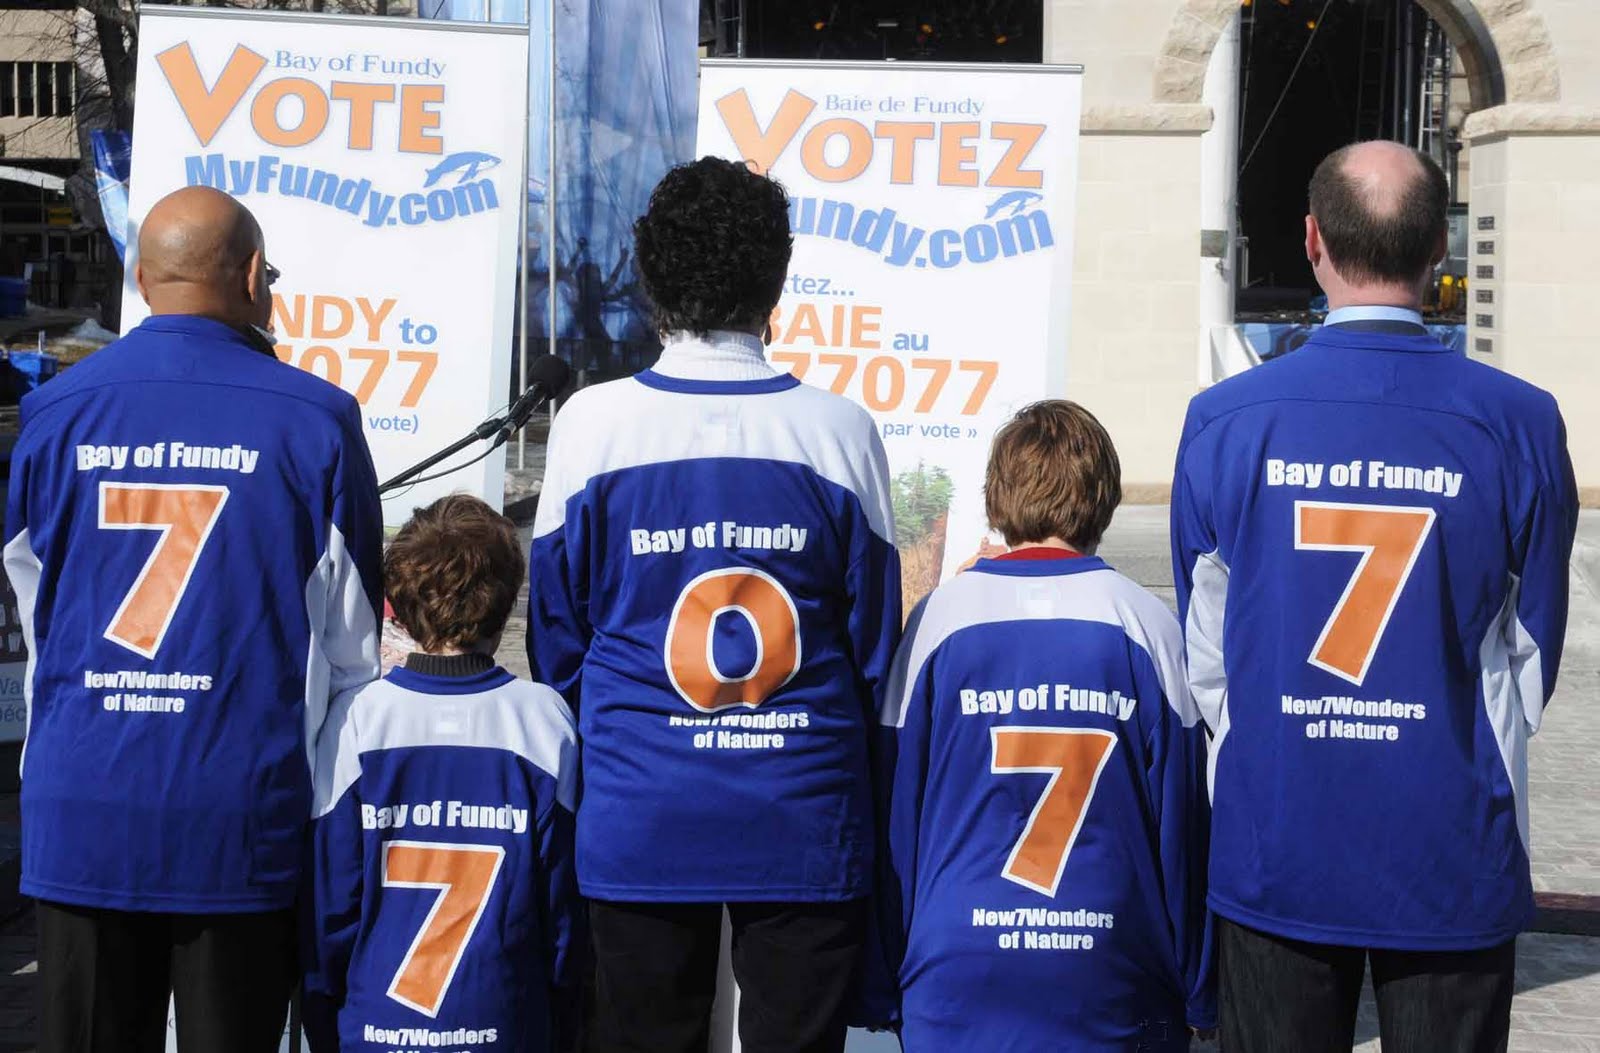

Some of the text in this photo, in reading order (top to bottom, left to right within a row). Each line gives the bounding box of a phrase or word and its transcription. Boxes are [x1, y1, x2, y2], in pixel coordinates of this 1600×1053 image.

[274, 49, 446, 78] Bay of Fundy
[825, 95, 985, 116] Baie de Fundy
[714, 87, 1047, 188] VOTEZ
[184, 153, 501, 228] MyFundy.com
[788, 197, 1055, 268] undy.com
[783, 274, 854, 296] tez...
[272, 293, 438, 345] NDY to
[770, 304, 929, 351] AIE au
[274, 345, 438, 408] 077
[369, 414, 419, 434] vote)
[882, 423, 913, 438] par
[920, 424, 960, 438] vote
[76, 442, 259, 473] Bay of Fundy
[1267, 459, 1463, 497] Bay of Fundy
[630, 522, 807, 555] Bay of Fundy
[98, 481, 230, 660] 7
[1294, 500, 1436, 686] 7
[104, 694, 185, 713] of Nature
[960, 689, 1014, 715] Bay
[1018, 684, 1049, 710] of
[1281, 695, 1425, 719] New7Wonders
[694, 731, 784, 749] of Nature
[1306, 720, 1398, 741] of Nature
[362, 801, 528, 833] Bay of Fundy
[990, 726, 1118, 898] 7
[383, 840, 505, 1018] 7
[972, 908, 1113, 928] New7Wonders
[999, 931, 1093, 949] of Nature
[364, 1024, 497, 1047] New7Wonders
